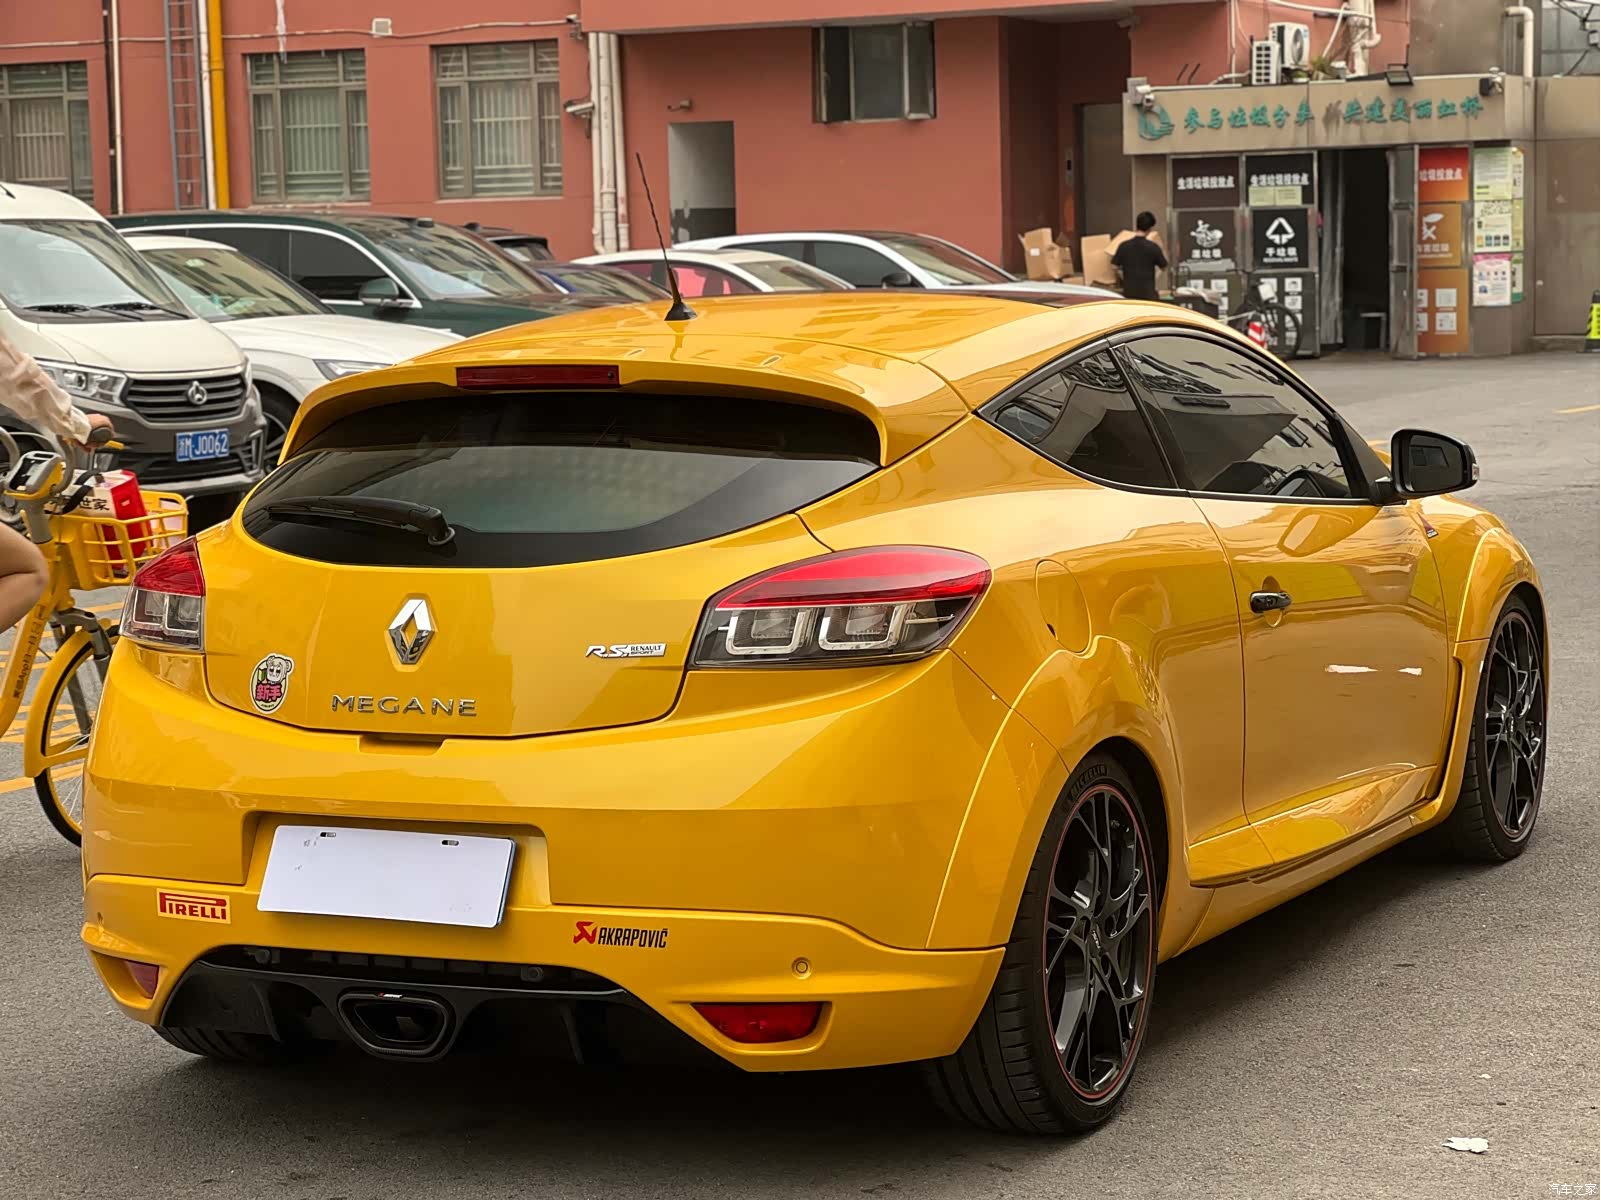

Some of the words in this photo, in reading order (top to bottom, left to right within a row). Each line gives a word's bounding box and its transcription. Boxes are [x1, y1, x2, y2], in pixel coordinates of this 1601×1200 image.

[256, 683, 282, 702] 新手
[331, 694, 478, 716] MEGANE
[159, 892, 227, 920] PIRELLI
[597, 927, 669, 948] AKRAPOVIČ
